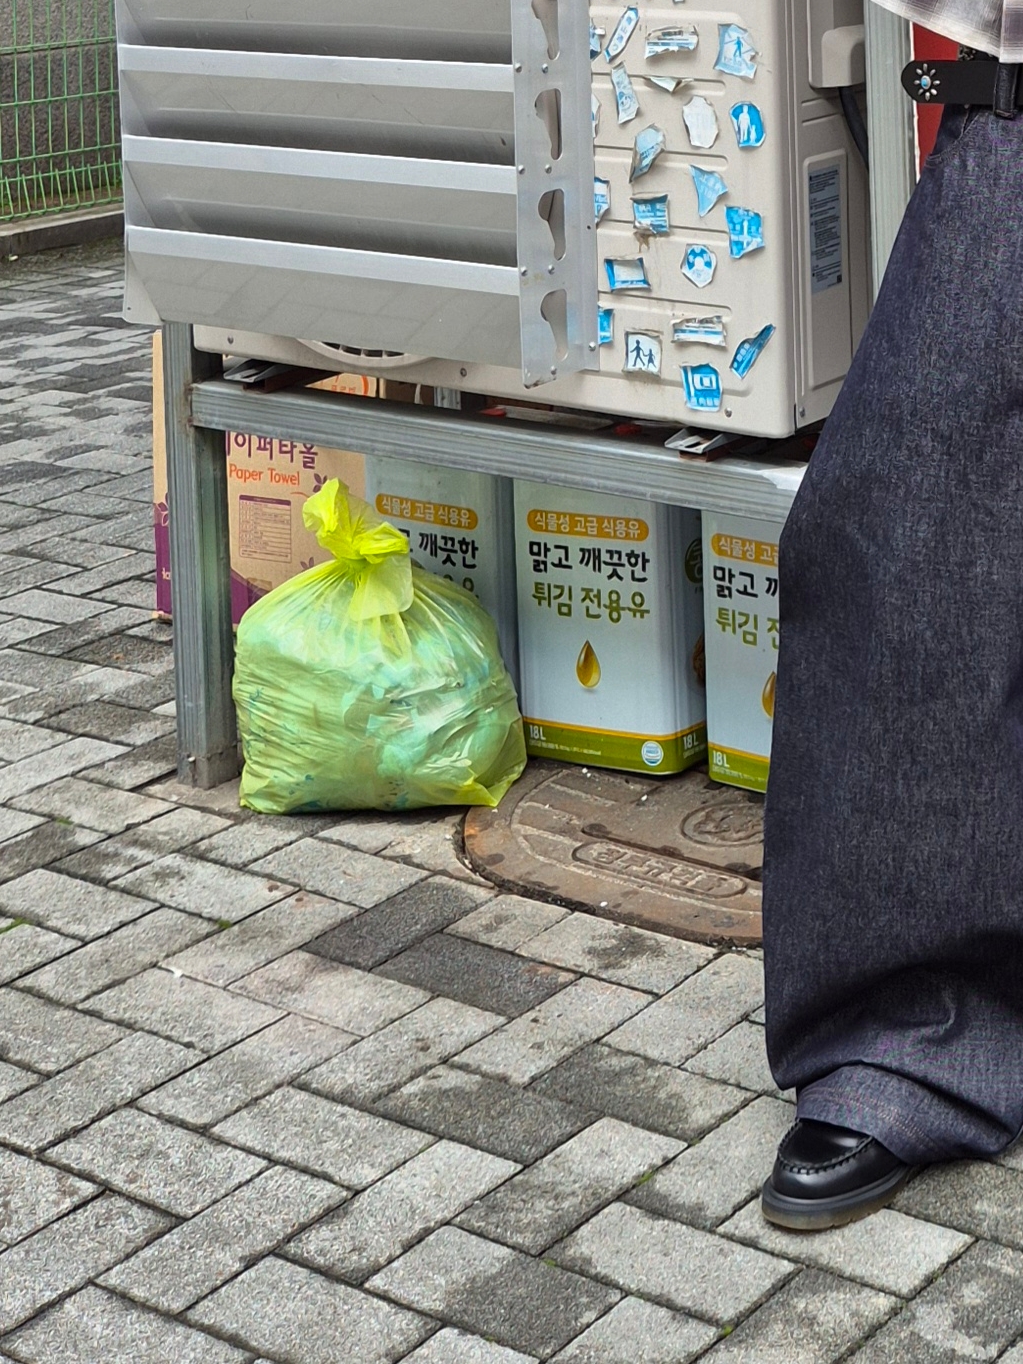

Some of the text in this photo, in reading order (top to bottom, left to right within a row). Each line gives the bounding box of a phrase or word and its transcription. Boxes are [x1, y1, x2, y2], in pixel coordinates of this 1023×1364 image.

[226, 431, 318, 470] 이퍼타올
[229, 464, 300, 486] Paper Towel
[382, 496, 471, 527] 식물성 고급 식용유
[534, 512, 641, 540] 식물성 고급 식용유
[419, 532, 479, 569] 깨끗한
[529, 541, 573, 573] 맑고
[579, 547, 650, 583] 깨끗한
[719, 536, 755, 560] 식물성
[713, 565, 758, 599] 맑고
[532, 582, 650, 624] 튀김 전용유
[716, 607, 758, 646] 튀김
